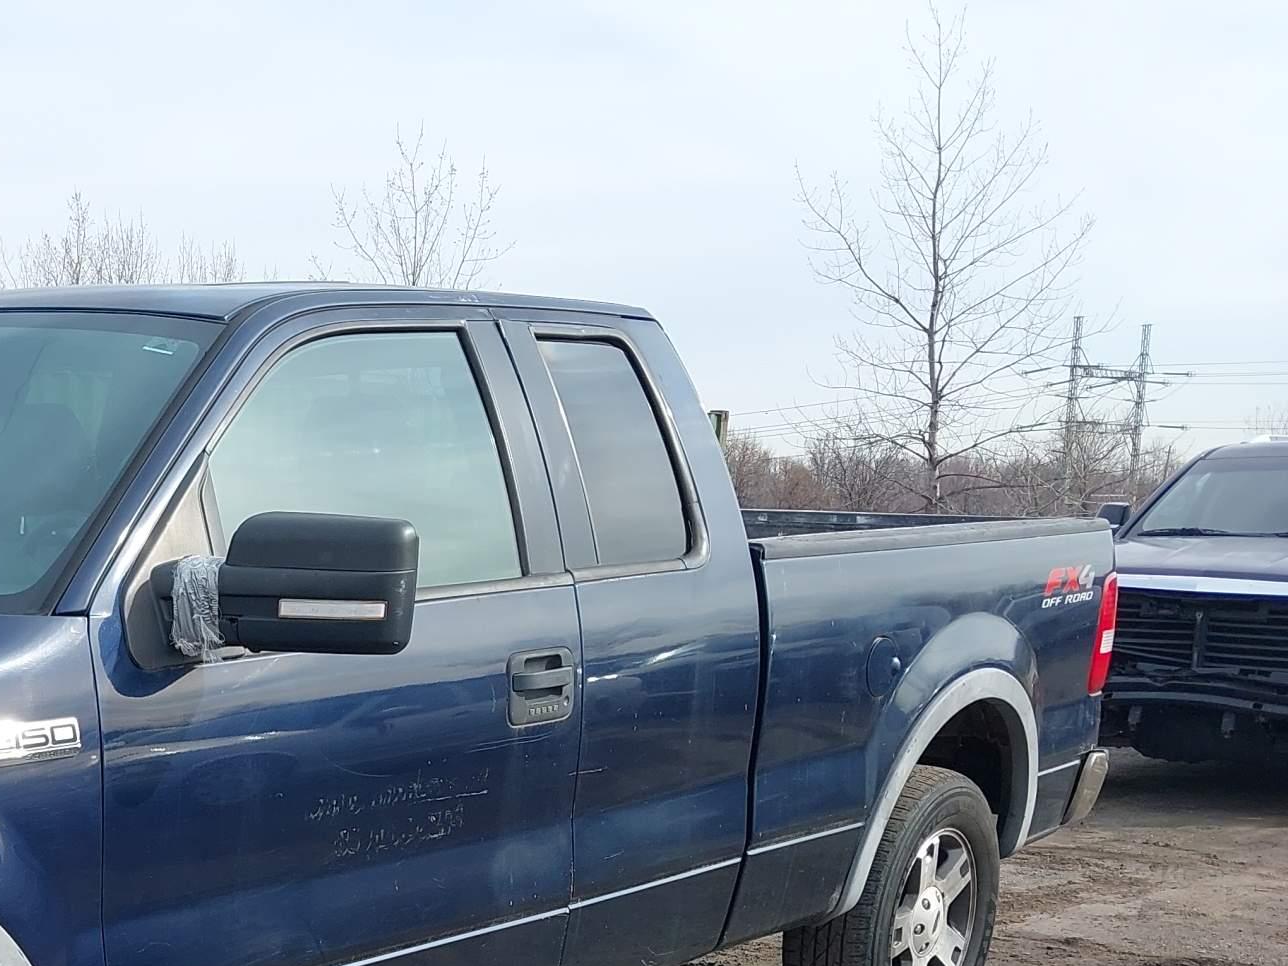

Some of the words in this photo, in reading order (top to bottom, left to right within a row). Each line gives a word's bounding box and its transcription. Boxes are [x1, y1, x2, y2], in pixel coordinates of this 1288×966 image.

[1043, 564, 1096, 597] FX4
[1041, 596, 1064, 609] OFF
[1064, 591, 1094, 605] ROAD
